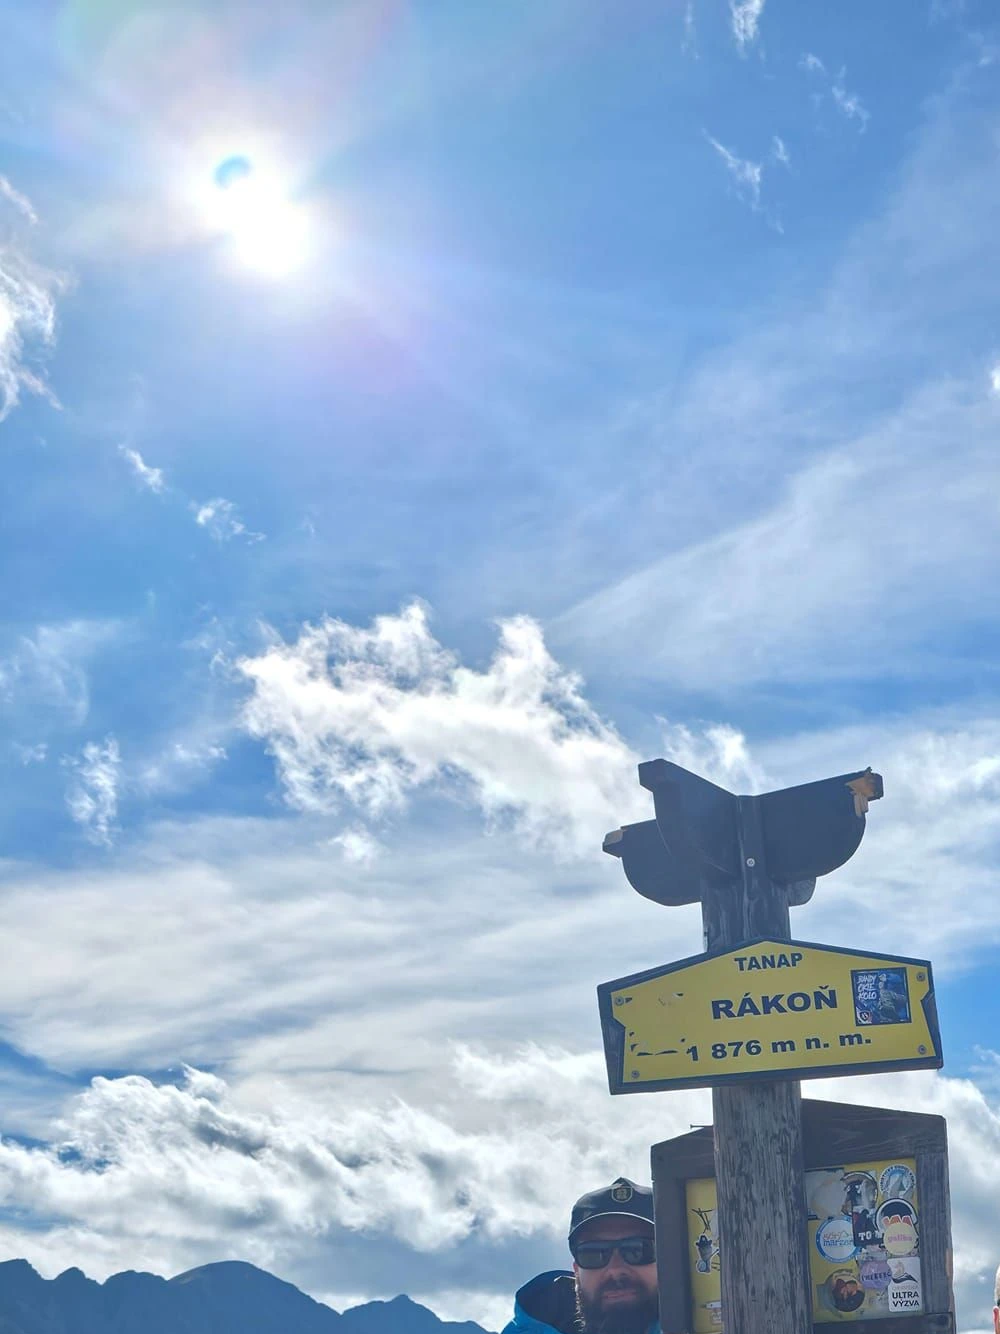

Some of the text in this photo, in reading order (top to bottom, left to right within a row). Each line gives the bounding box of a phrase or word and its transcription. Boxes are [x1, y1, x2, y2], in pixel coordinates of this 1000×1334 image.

[734, 952, 803, 971] TANAP
[711, 985, 838, 1020] RÁKOŇ
[686, 1032, 871, 1062] 1 876 m n. m.
[892, 1291, 920, 1299] ULTRA
[893, 1299, 920, 1308] VÝZVA
